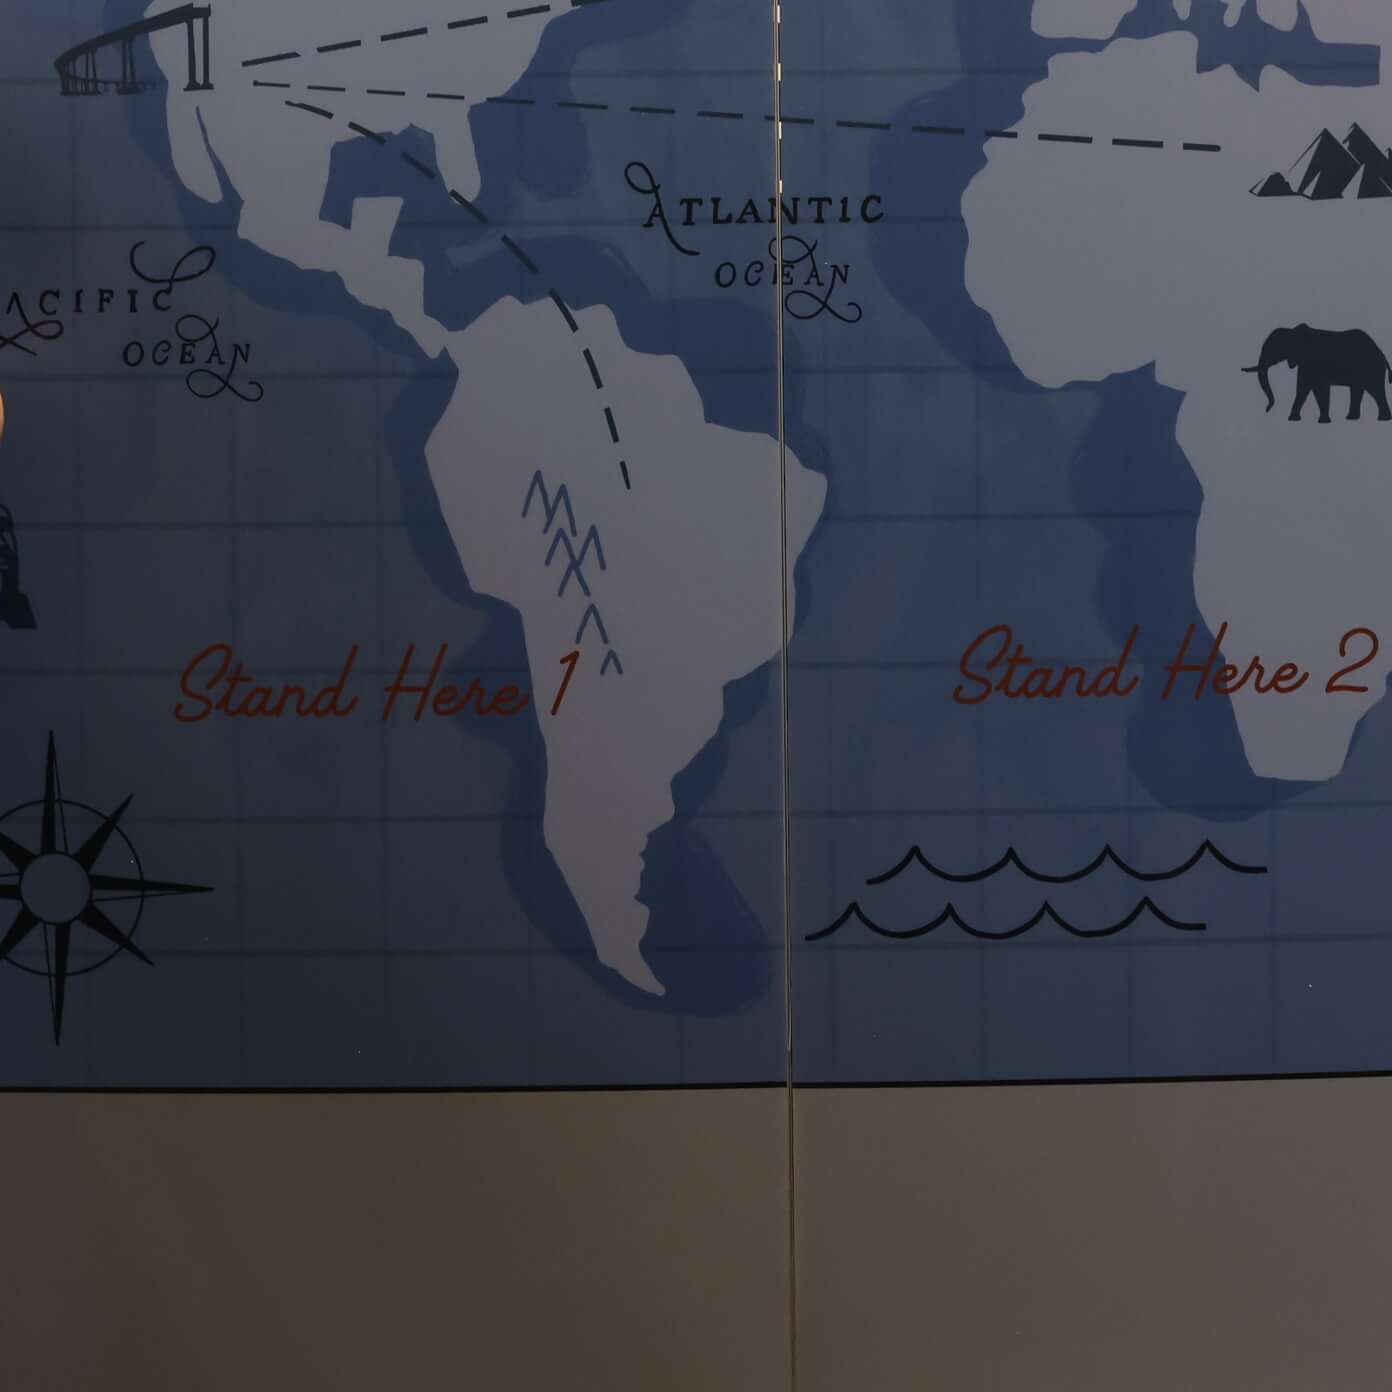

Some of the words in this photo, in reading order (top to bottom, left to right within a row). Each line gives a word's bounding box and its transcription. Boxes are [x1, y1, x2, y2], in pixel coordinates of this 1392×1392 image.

[173, 642, 360, 723] Stand
[381, 642, 531, 722] Here
[549, 649, 581, 717] 1
[952, 622, 1142, 706] Stand
[1159, 620, 1311, 701] Here
[1323, 626, 1380, 694] 2
